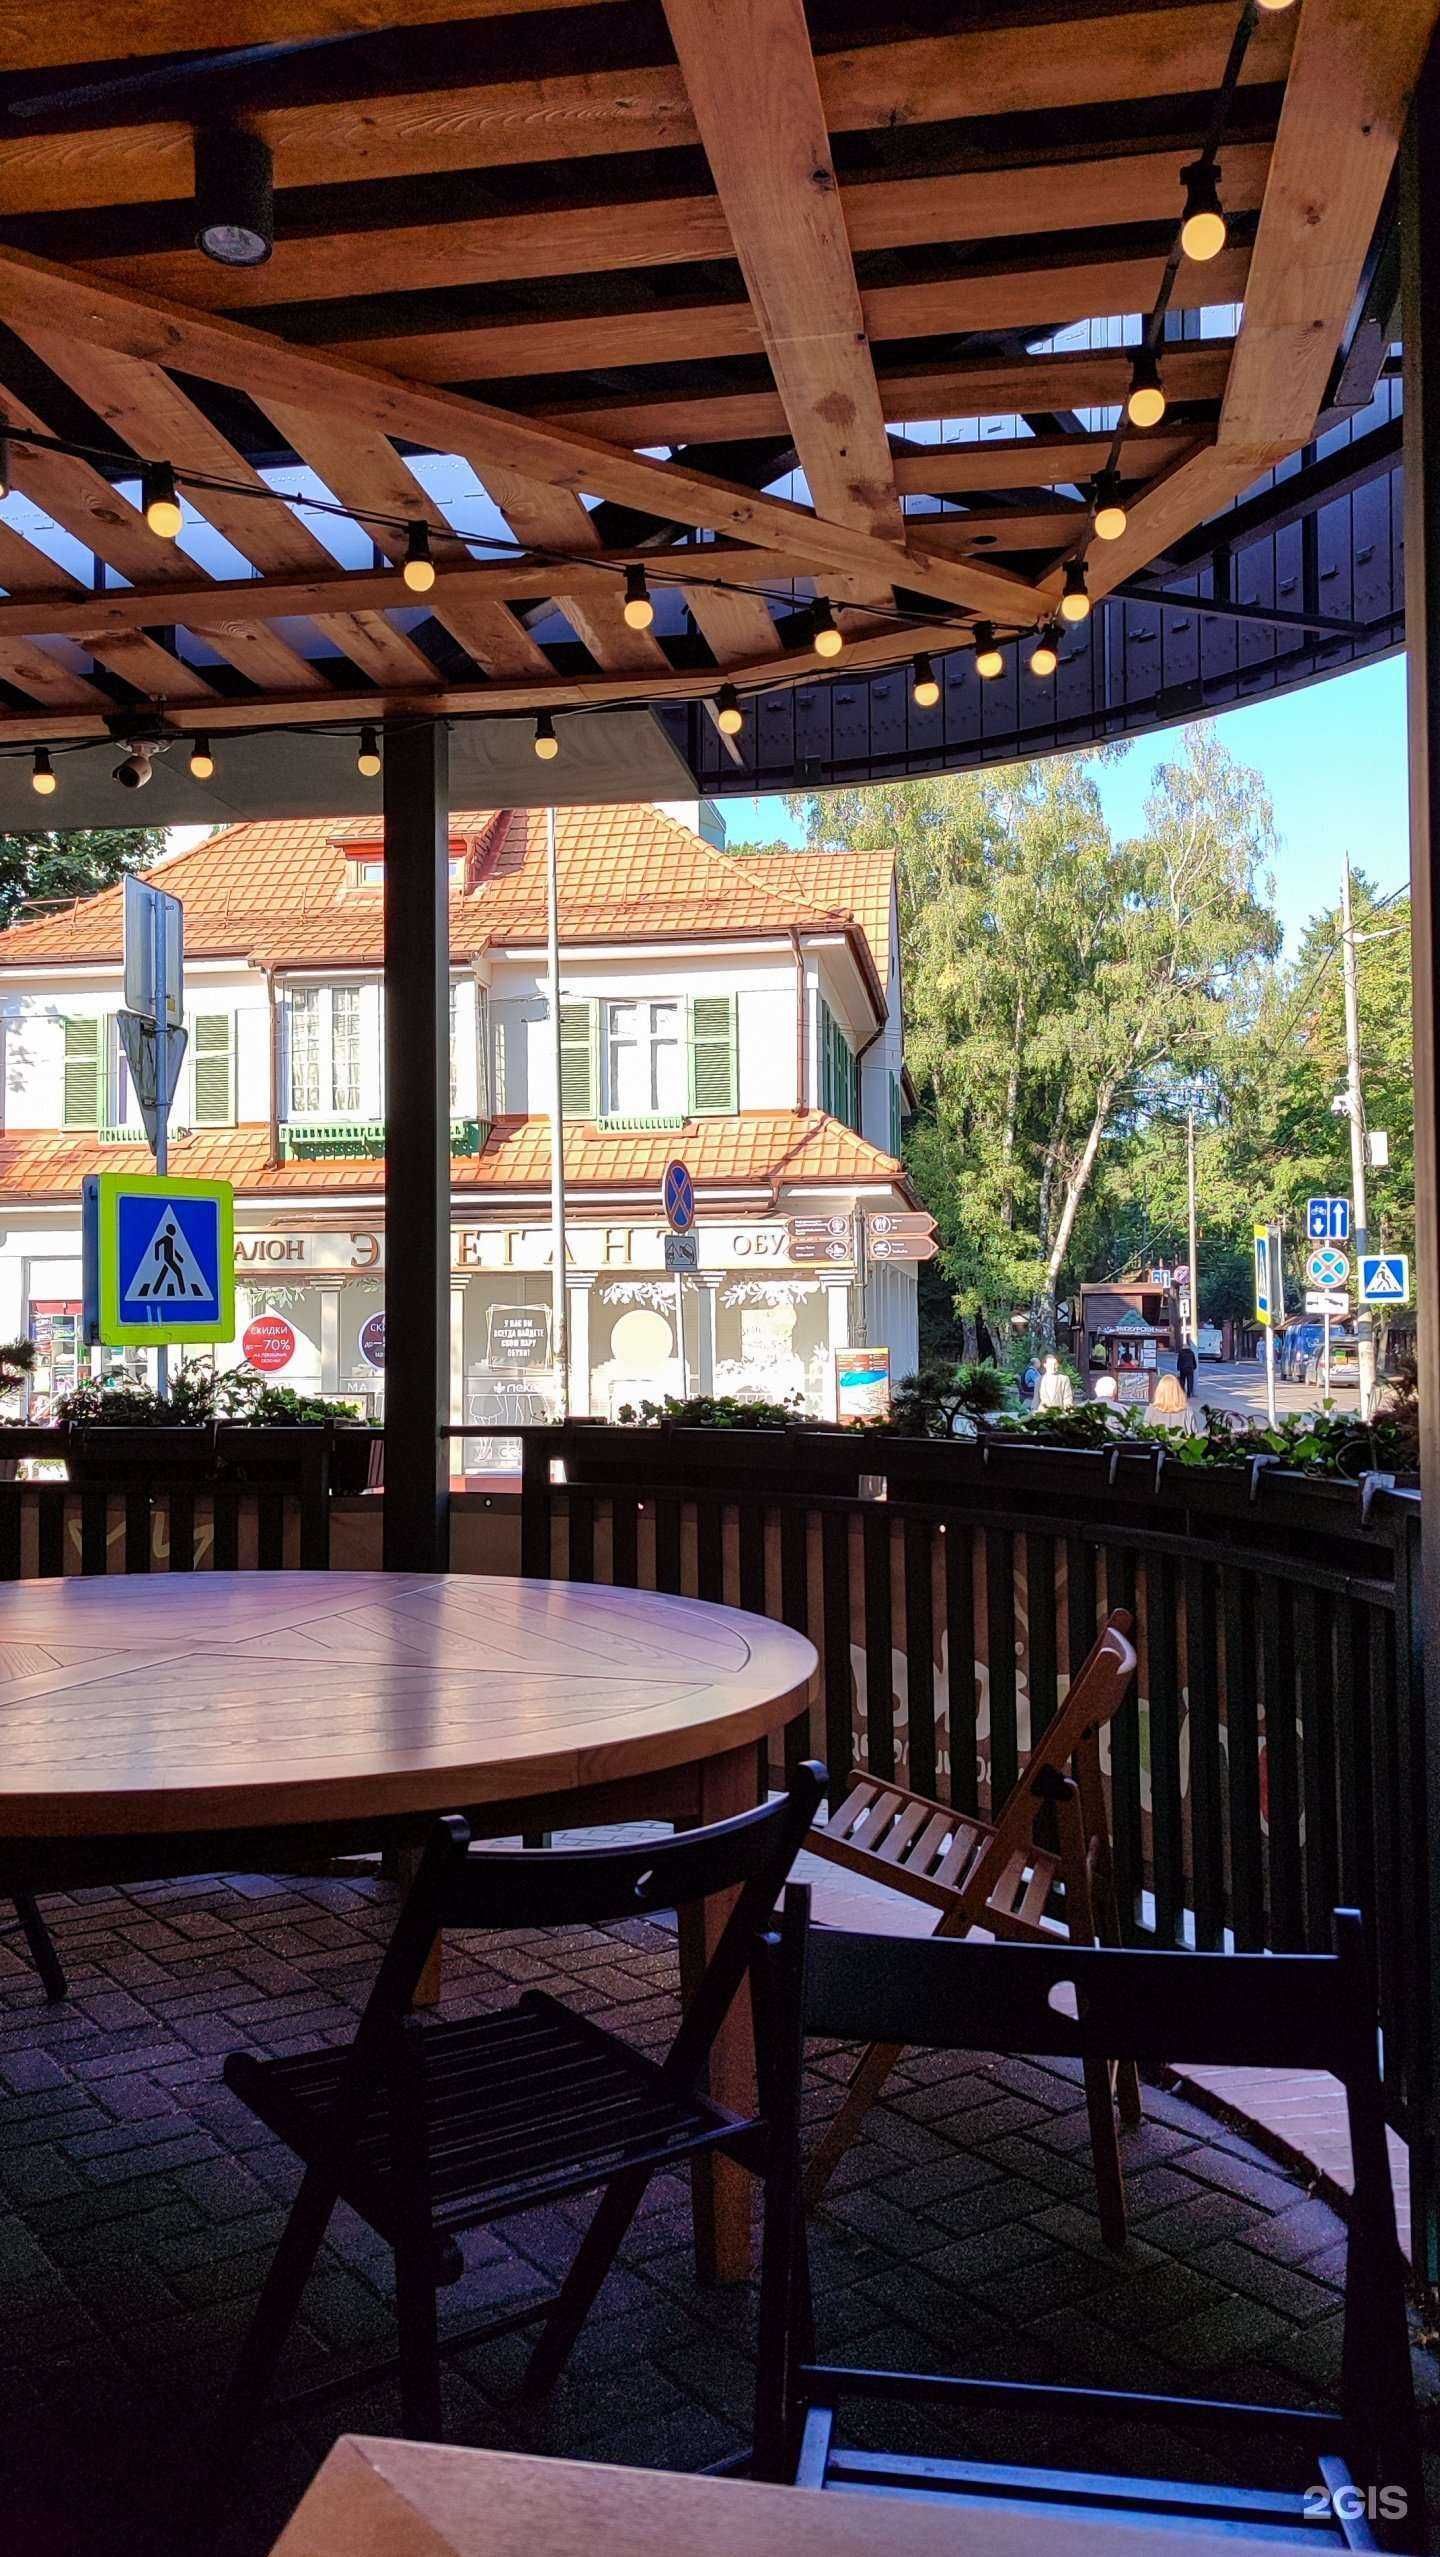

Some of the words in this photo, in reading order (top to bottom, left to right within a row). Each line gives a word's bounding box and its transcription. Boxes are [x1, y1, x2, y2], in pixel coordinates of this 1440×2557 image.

[234, 1240, 304, 1260] АЛОН
[732, 1234, 785, 1256] ОБУ
[250, 1326, 288, 1335] СКИДКИ
[494, 1329, 516, 1338] ВСЕГДА
